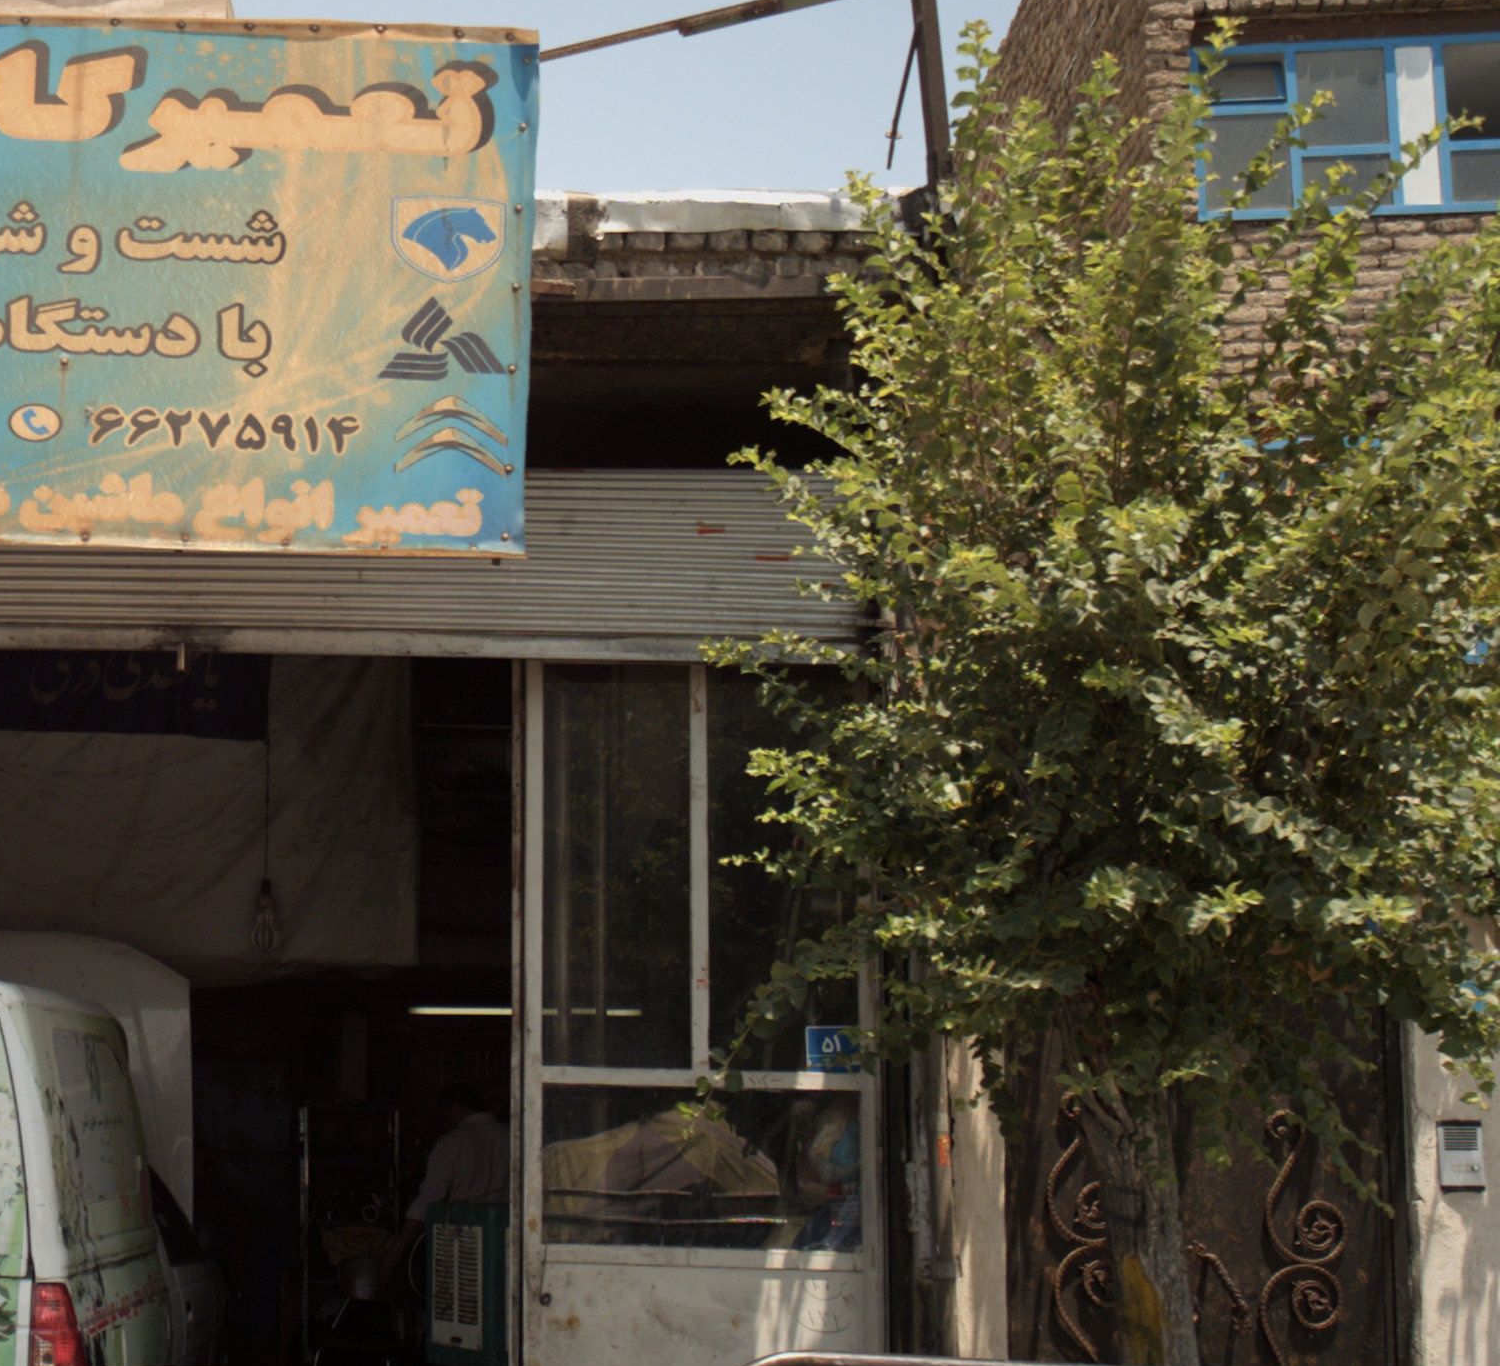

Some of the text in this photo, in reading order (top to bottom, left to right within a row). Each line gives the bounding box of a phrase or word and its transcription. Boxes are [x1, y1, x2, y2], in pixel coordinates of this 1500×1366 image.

[58, 224, 102, 273] و
[116, 210, 287, 264] شست
[216, 303, 272, 378] با
[89, 405, 361, 455] ۶۶۲۷۵۹۱۴
[19, 472, 186, 532] ماشین
[193, 477, 336, 544] انواع
[342, 488, 485, 546] تعمیر
